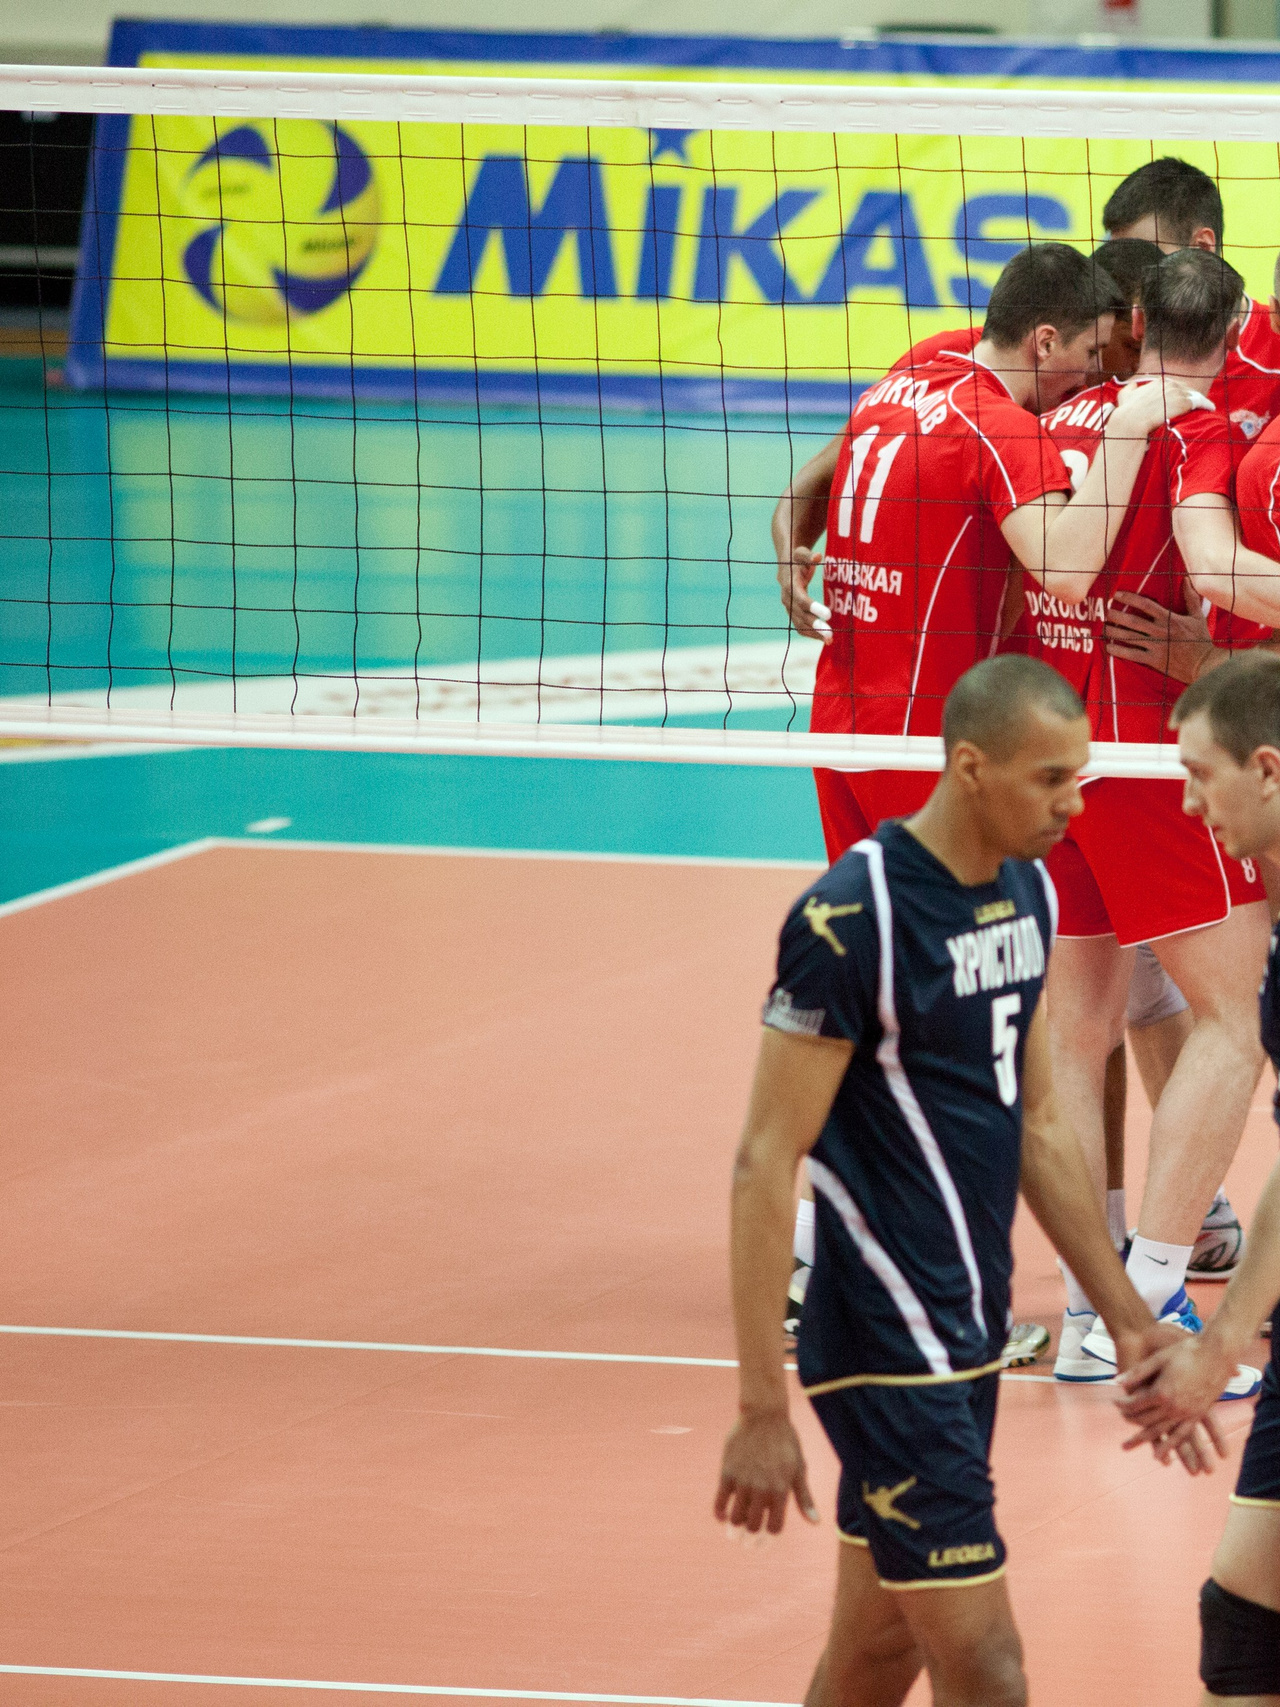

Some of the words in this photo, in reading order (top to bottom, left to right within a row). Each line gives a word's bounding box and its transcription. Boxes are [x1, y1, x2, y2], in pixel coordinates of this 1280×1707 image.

[432, 154, 1076, 312] MIKAS
[838, 425, 907, 544] 11
[991, 993, 1022, 1107] 5
